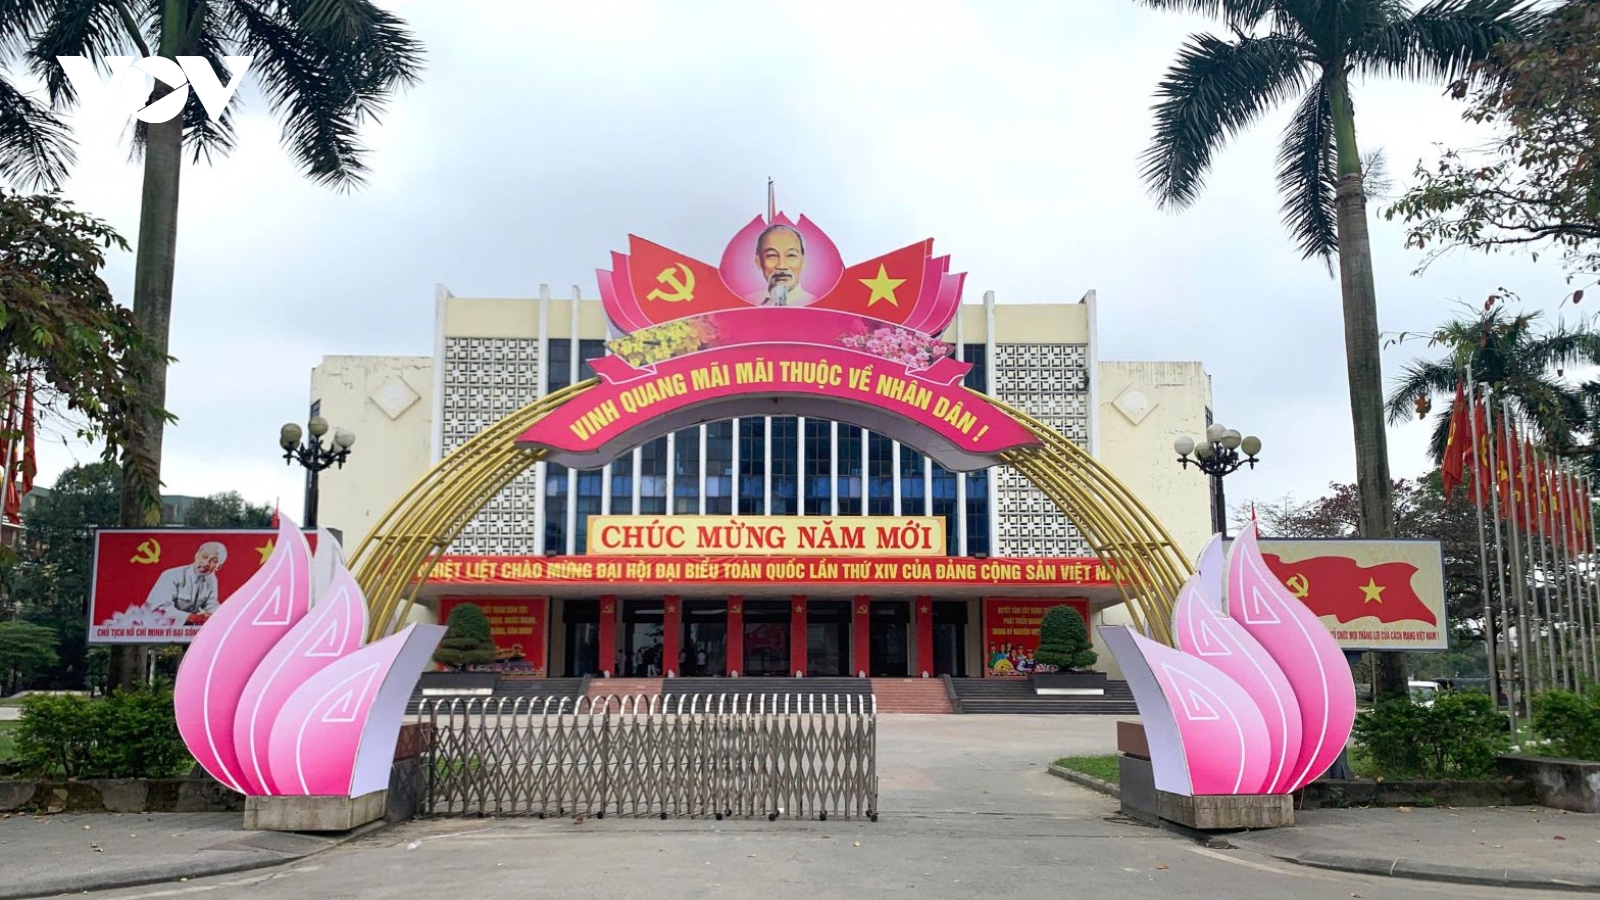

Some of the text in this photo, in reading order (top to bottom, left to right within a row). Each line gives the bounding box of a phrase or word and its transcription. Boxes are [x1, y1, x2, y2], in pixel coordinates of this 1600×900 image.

[569, 357, 989, 442] VINH QUANG MÃI MÃI THUỘC VỀ NHÂN DÂN !
[601, 519, 932, 549] CHÚC MỪNG NĂM MỚI
[466, 559, 498, 581] LIỆT
[502, 559, 542, 579] CHÀO
[547, 559, 592, 579] MỪNG
[596, 562, 622, 582] ĐẠI
[626, 560, 651, 582] HỘI
[655, 562, 681, 582] ĐẠI
[685, 557, 719, 579] BIỂU
[724, 560, 761, 579] TOÀN
[766, 558, 805, 580] QUỐC
[810, 558, 838, 579] LẦN
[842, 560, 871, 579] THỨ
[875, 563, 898, 579] XIV
[902, 559, 932, 579] CỦA
[936, 559, 976, 580] ĐẢNG
[981, 561, 1021, 583] CỘNG
[1025, 559, 1056, 580] SẢN
[1060, 561, 1091, 583] VIỆT
[97, 626, 109, 637] CHỦ
[111, 628, 124, 638] TỊCH
[136, 627, 146, 637] CHÍ
[148, 628, 164, 637] MINH
[185, 627, 199, 637] SỐN
